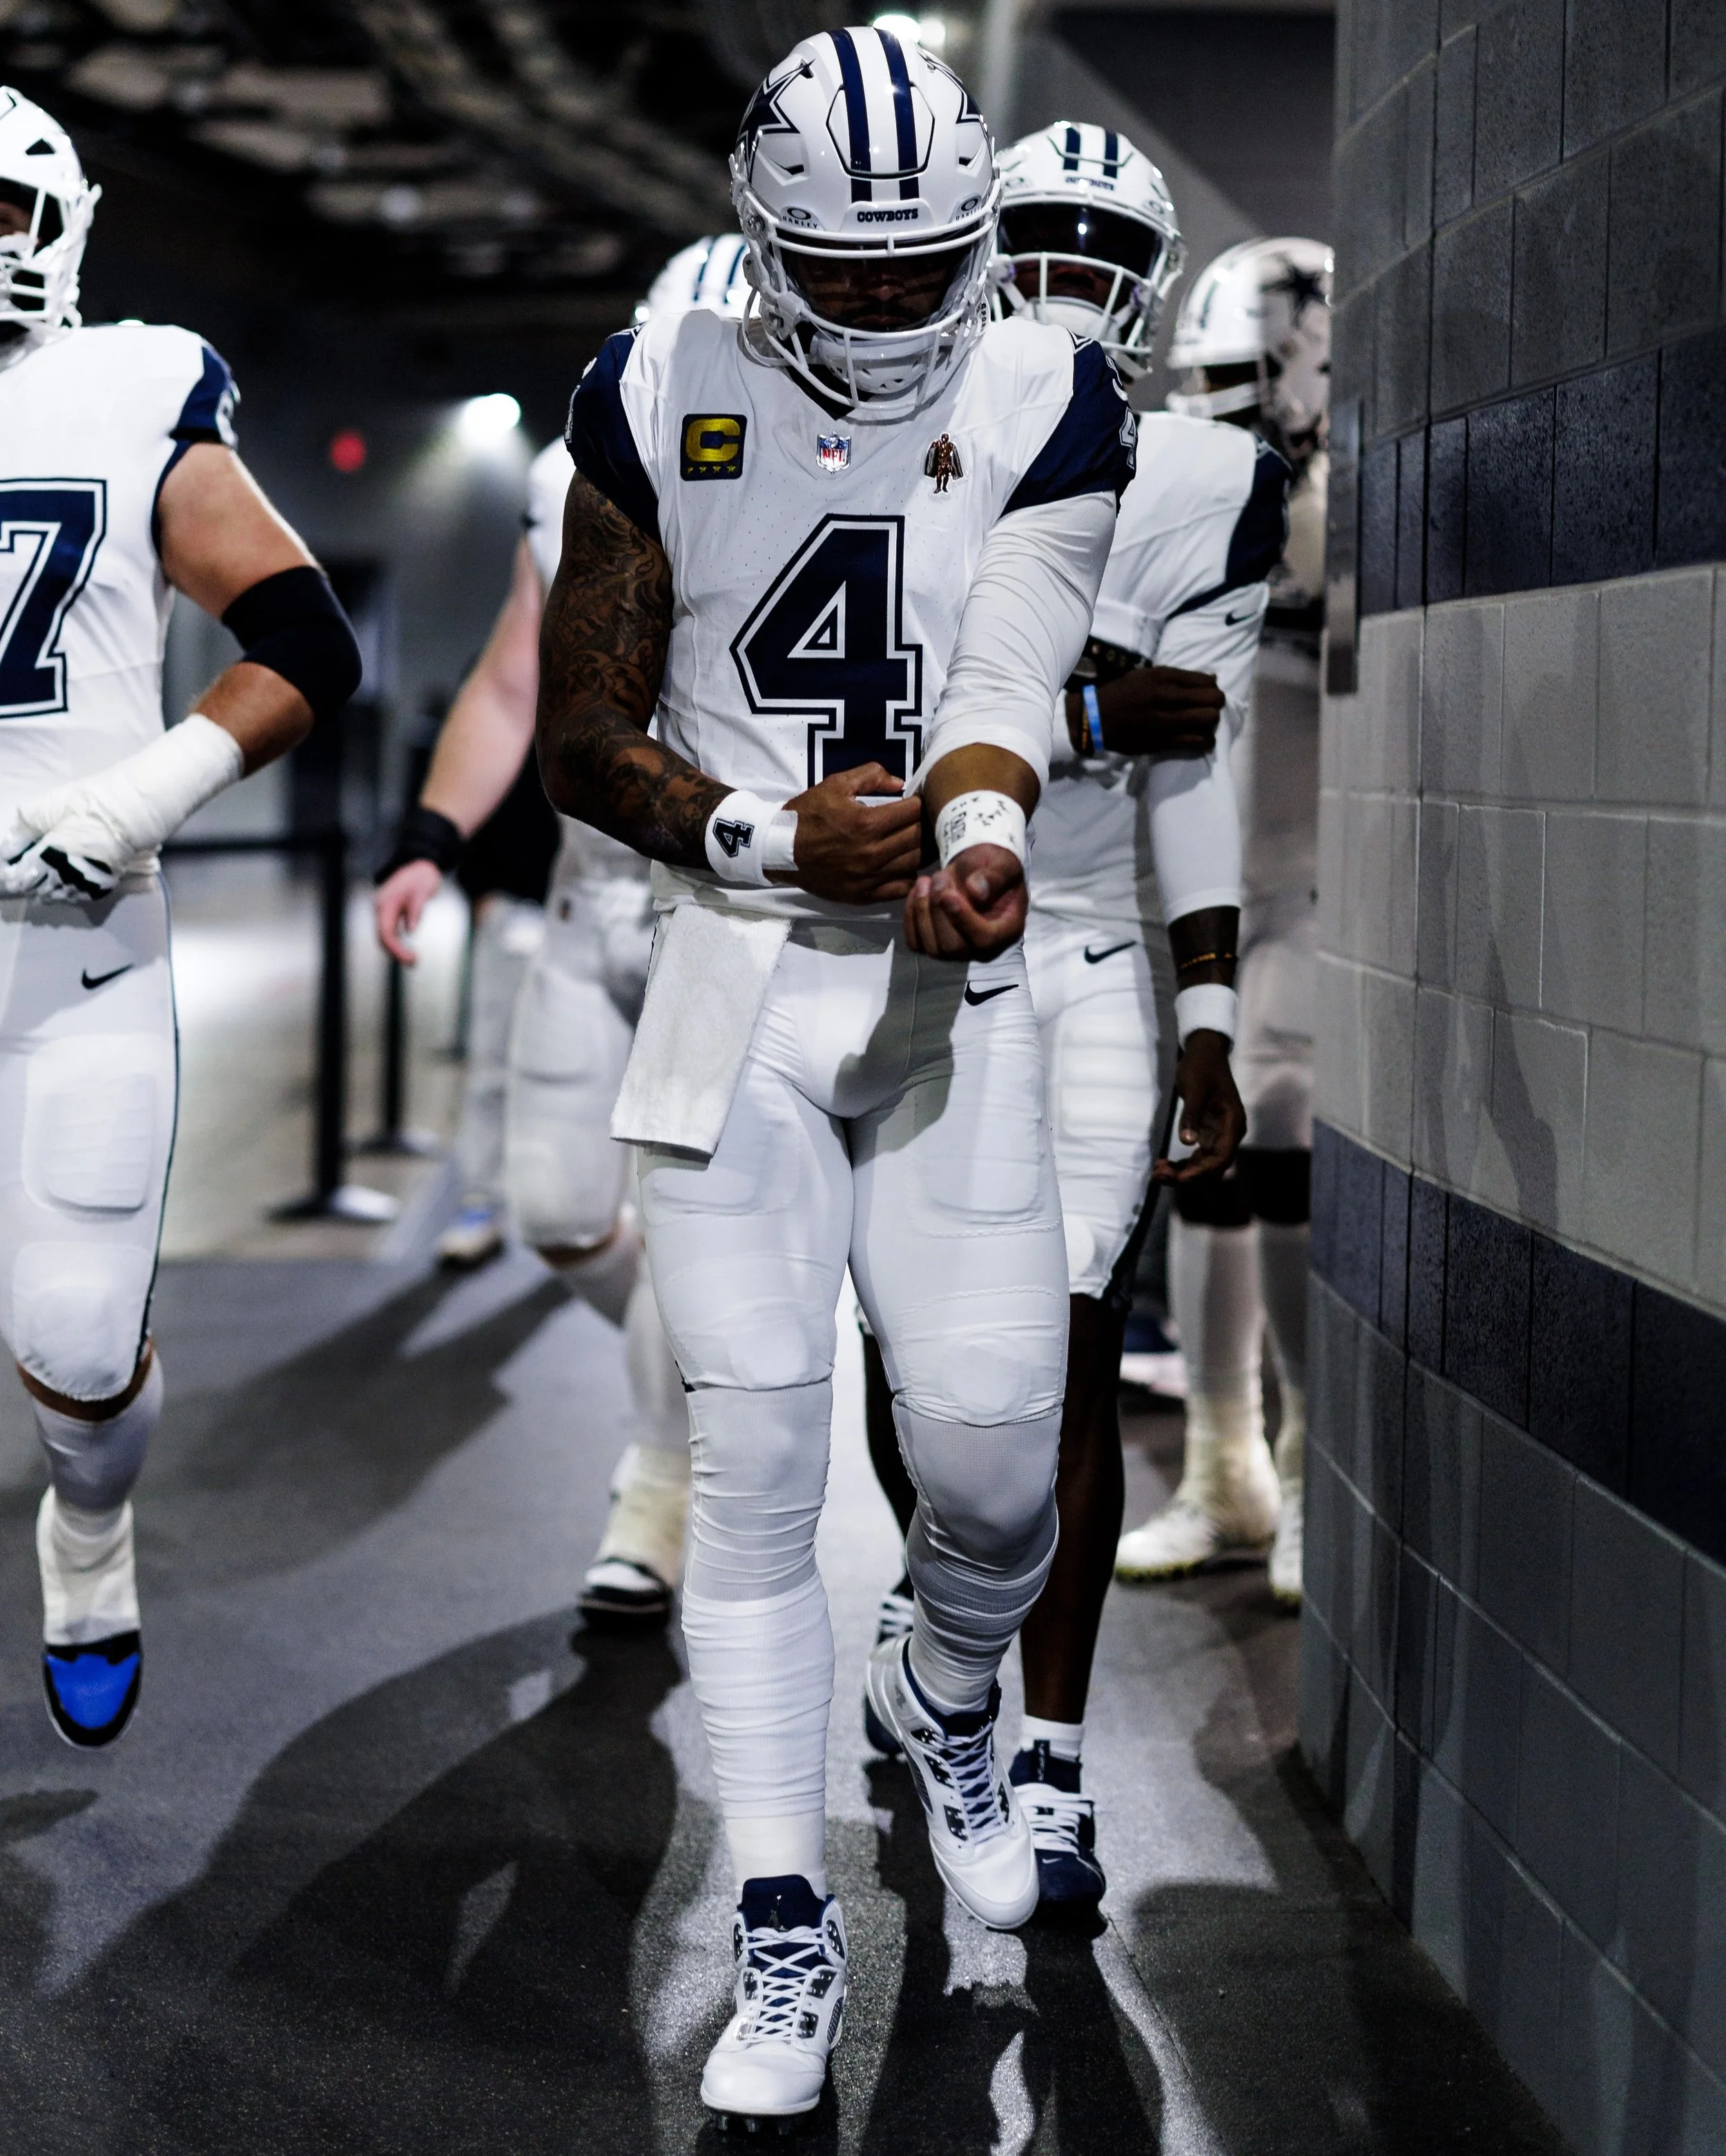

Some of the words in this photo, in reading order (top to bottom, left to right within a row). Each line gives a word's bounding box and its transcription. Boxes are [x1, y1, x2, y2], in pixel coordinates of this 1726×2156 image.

[782, 215, 818, 229] OAKLEY
[857, 209, 918, 222] COWBOYS
[686, 418, 741, 462] C
[822, 448, 845, 463] NFL
[728, 512, 923, 797] 4
[712, 811, 755, 858] 4
